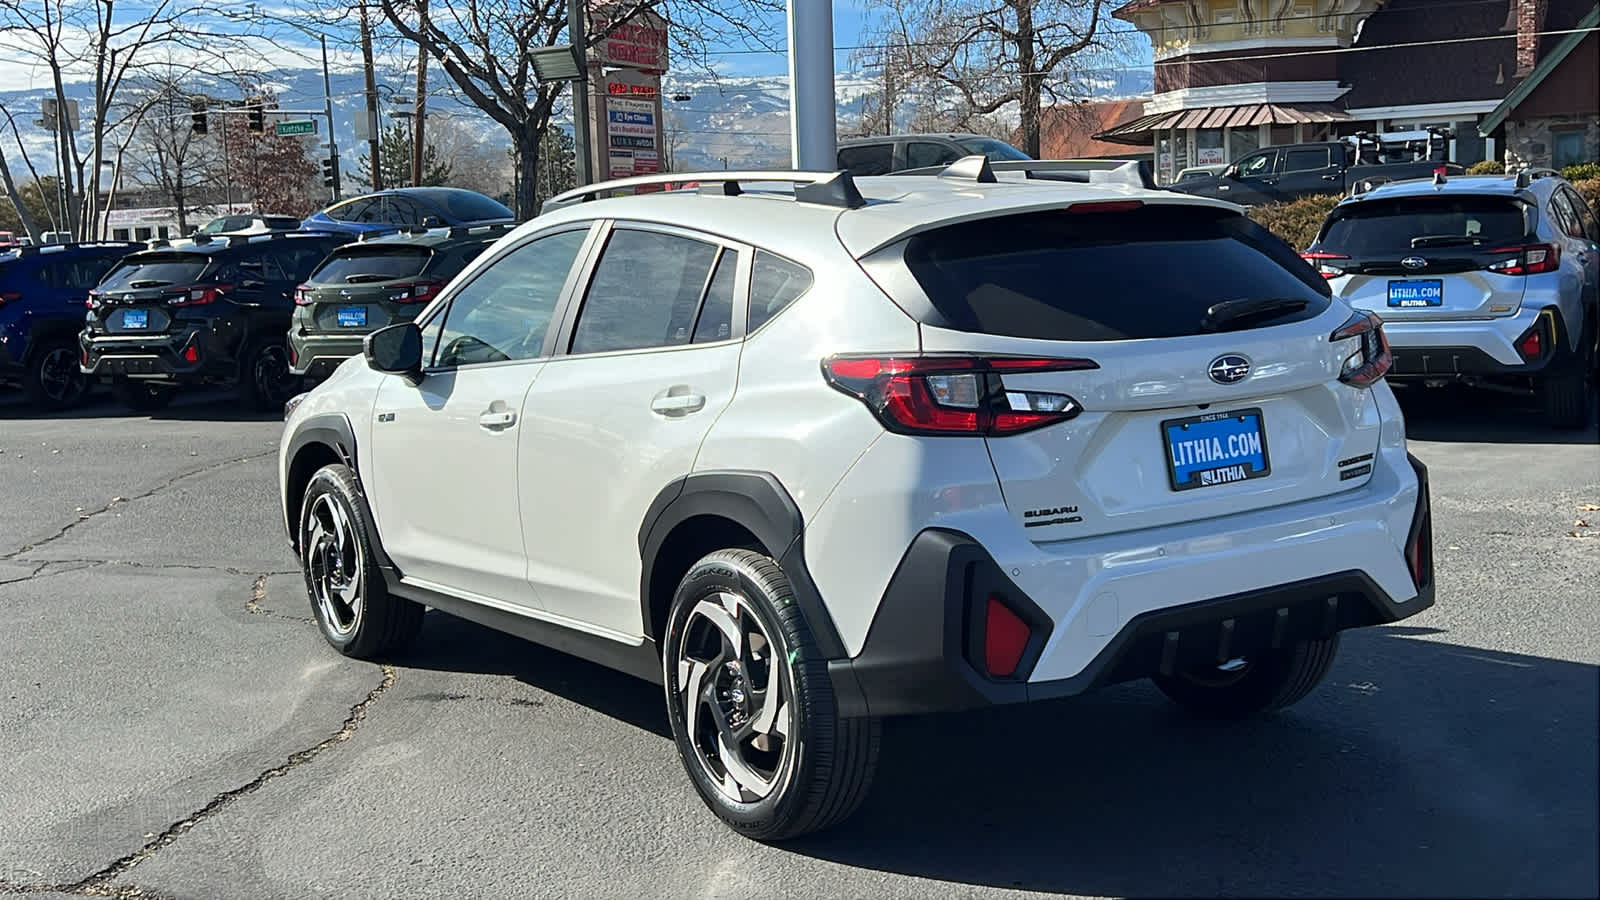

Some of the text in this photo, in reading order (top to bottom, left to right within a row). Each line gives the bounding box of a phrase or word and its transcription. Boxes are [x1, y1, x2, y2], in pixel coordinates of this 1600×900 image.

[608, 82, 656, 98] CAR WASH
[1389, 287, 1441, 299] LITHIA.COM
[1200, 414, 1216, 422] SINCE
[1171, 431, 1262, 467] LITHIA.COM
[1211, 464, 1247, 484] LITHIA
[1024, 505, 1078, 518] SUBARU
